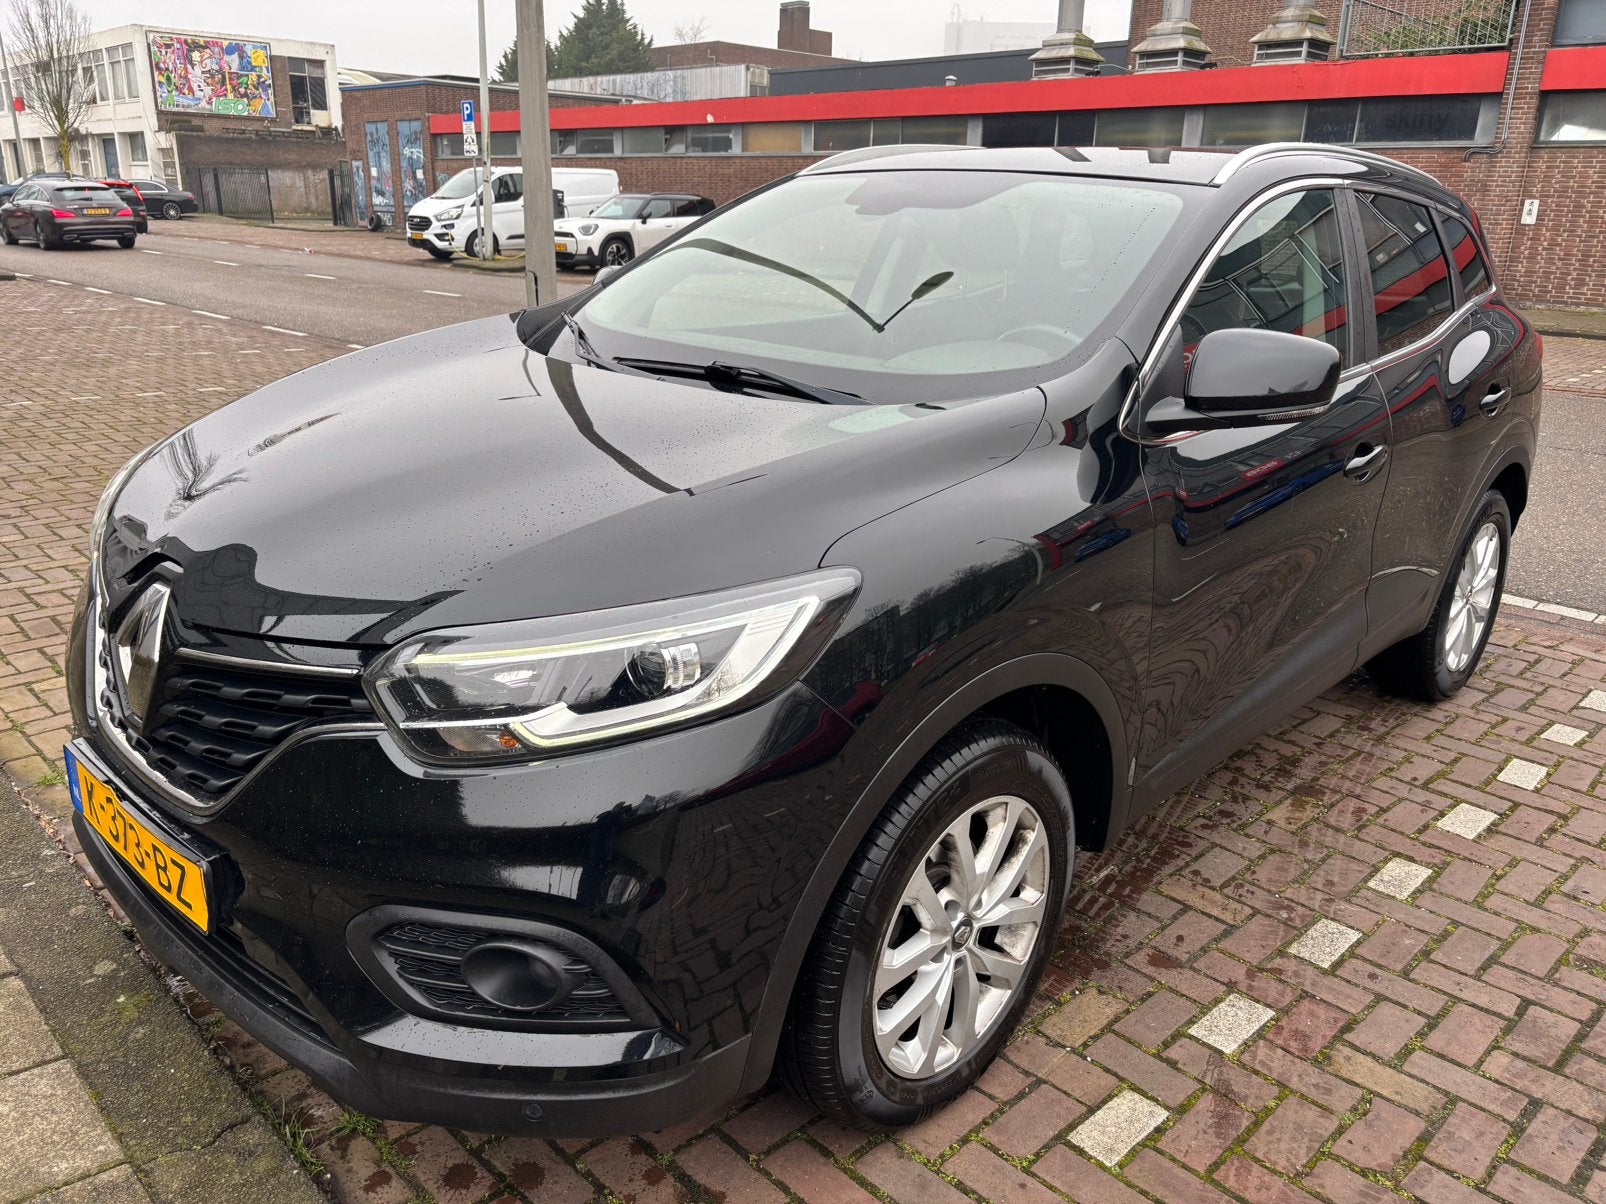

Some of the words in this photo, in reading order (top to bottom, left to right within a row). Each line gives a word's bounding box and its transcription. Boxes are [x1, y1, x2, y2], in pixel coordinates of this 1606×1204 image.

[214, 98, 248, 115] ISO
[463, 103, 471, 121] P
[84, 775, 193, 911] K-373-BZ
